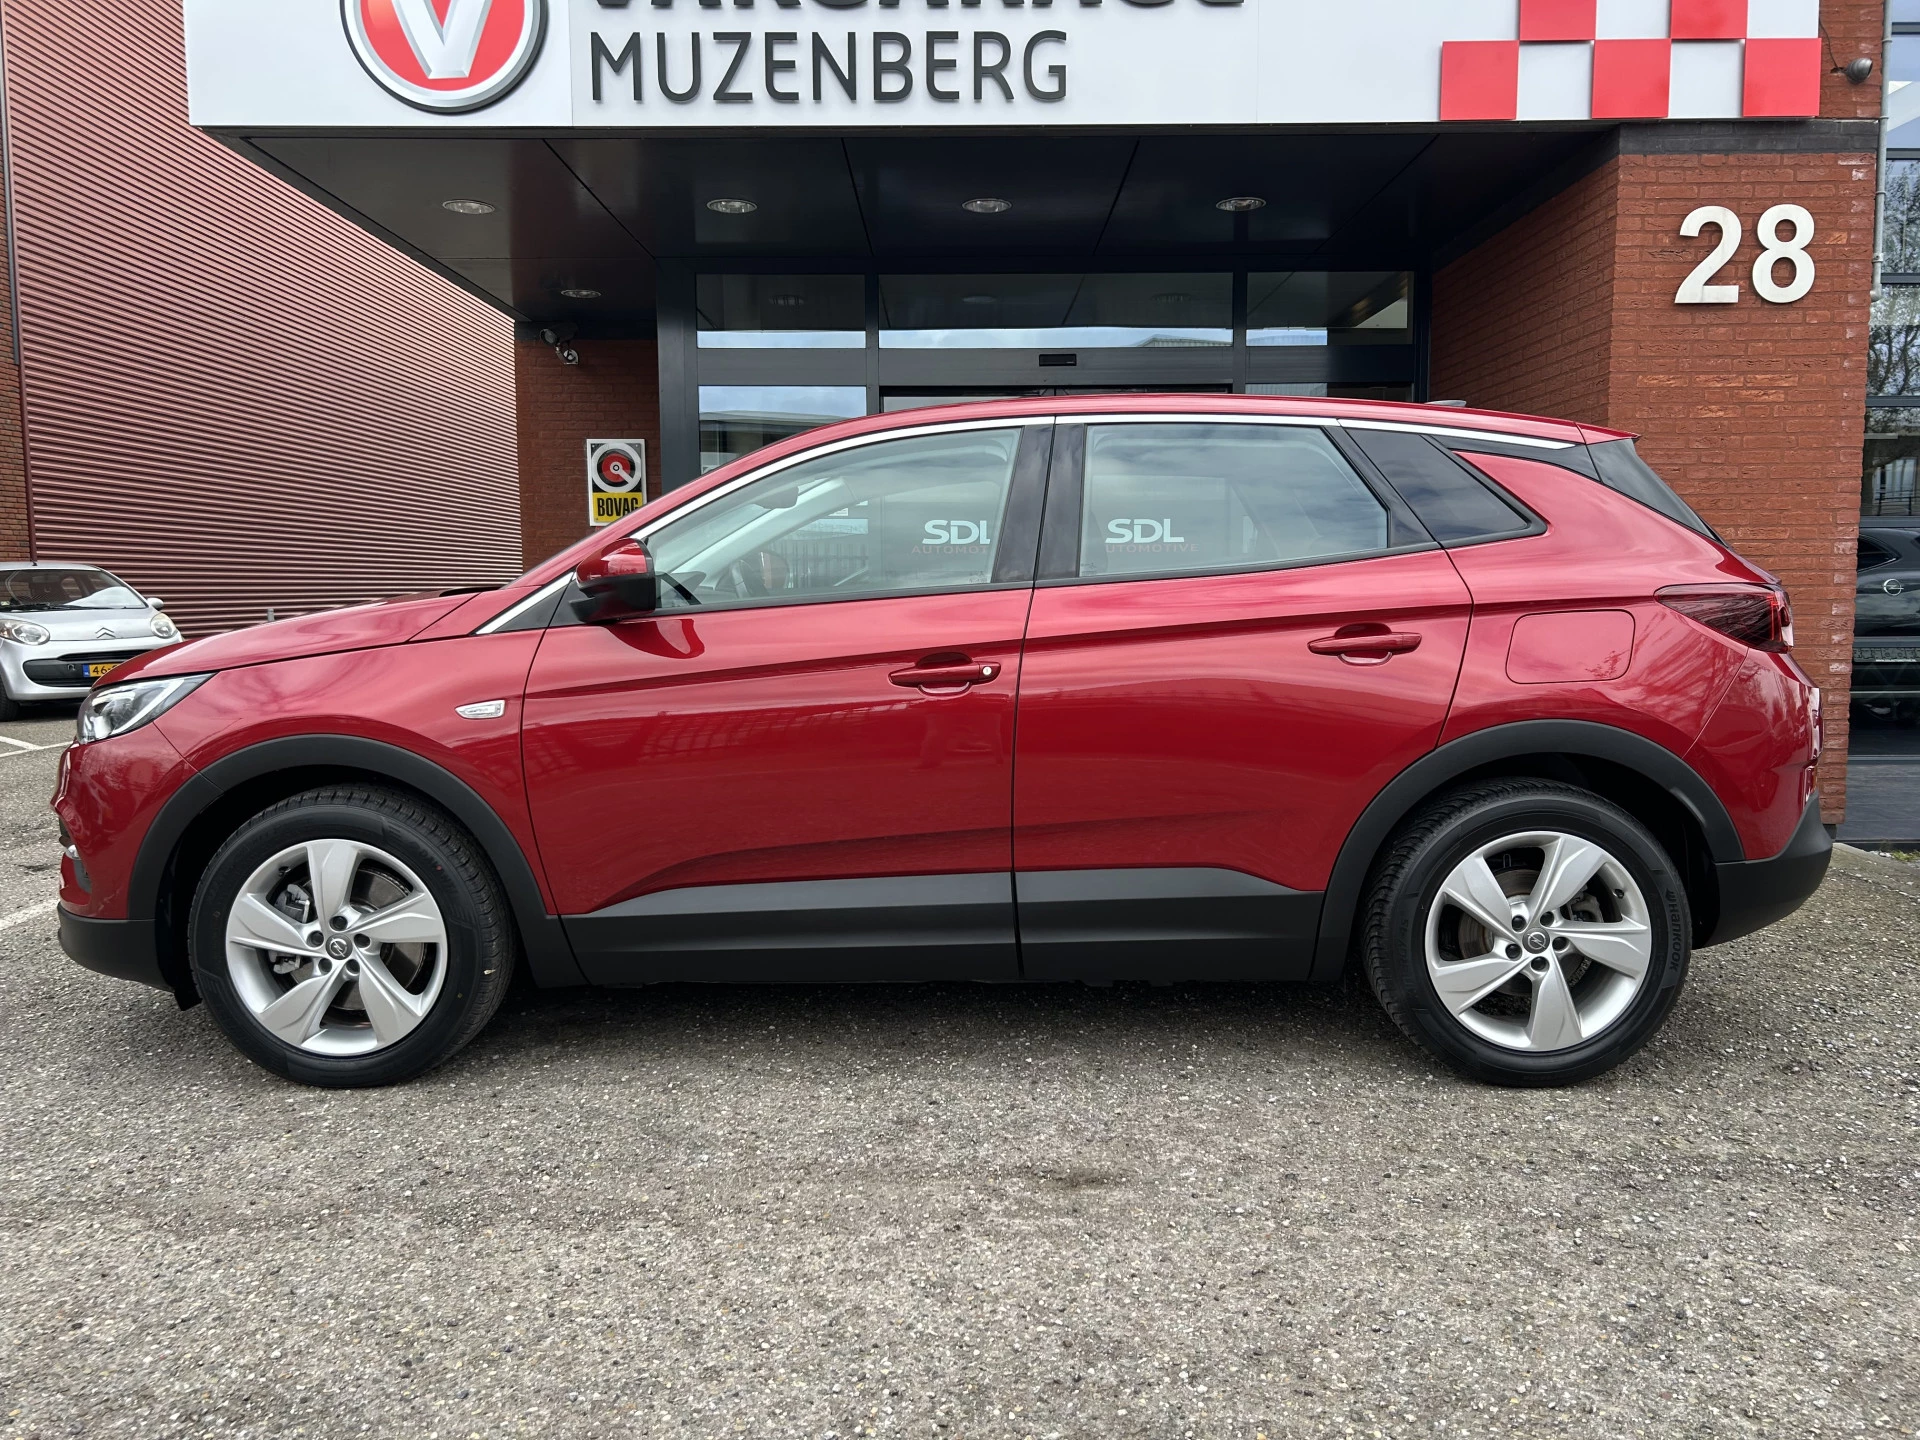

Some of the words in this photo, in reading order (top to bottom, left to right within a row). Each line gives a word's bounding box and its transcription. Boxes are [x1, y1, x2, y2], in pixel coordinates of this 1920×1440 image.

[590, 30, 1067, 102] MUZENBERG
[1674, 204, 1815, 304] 28
[1104, 518, 1185, 544] SDL
